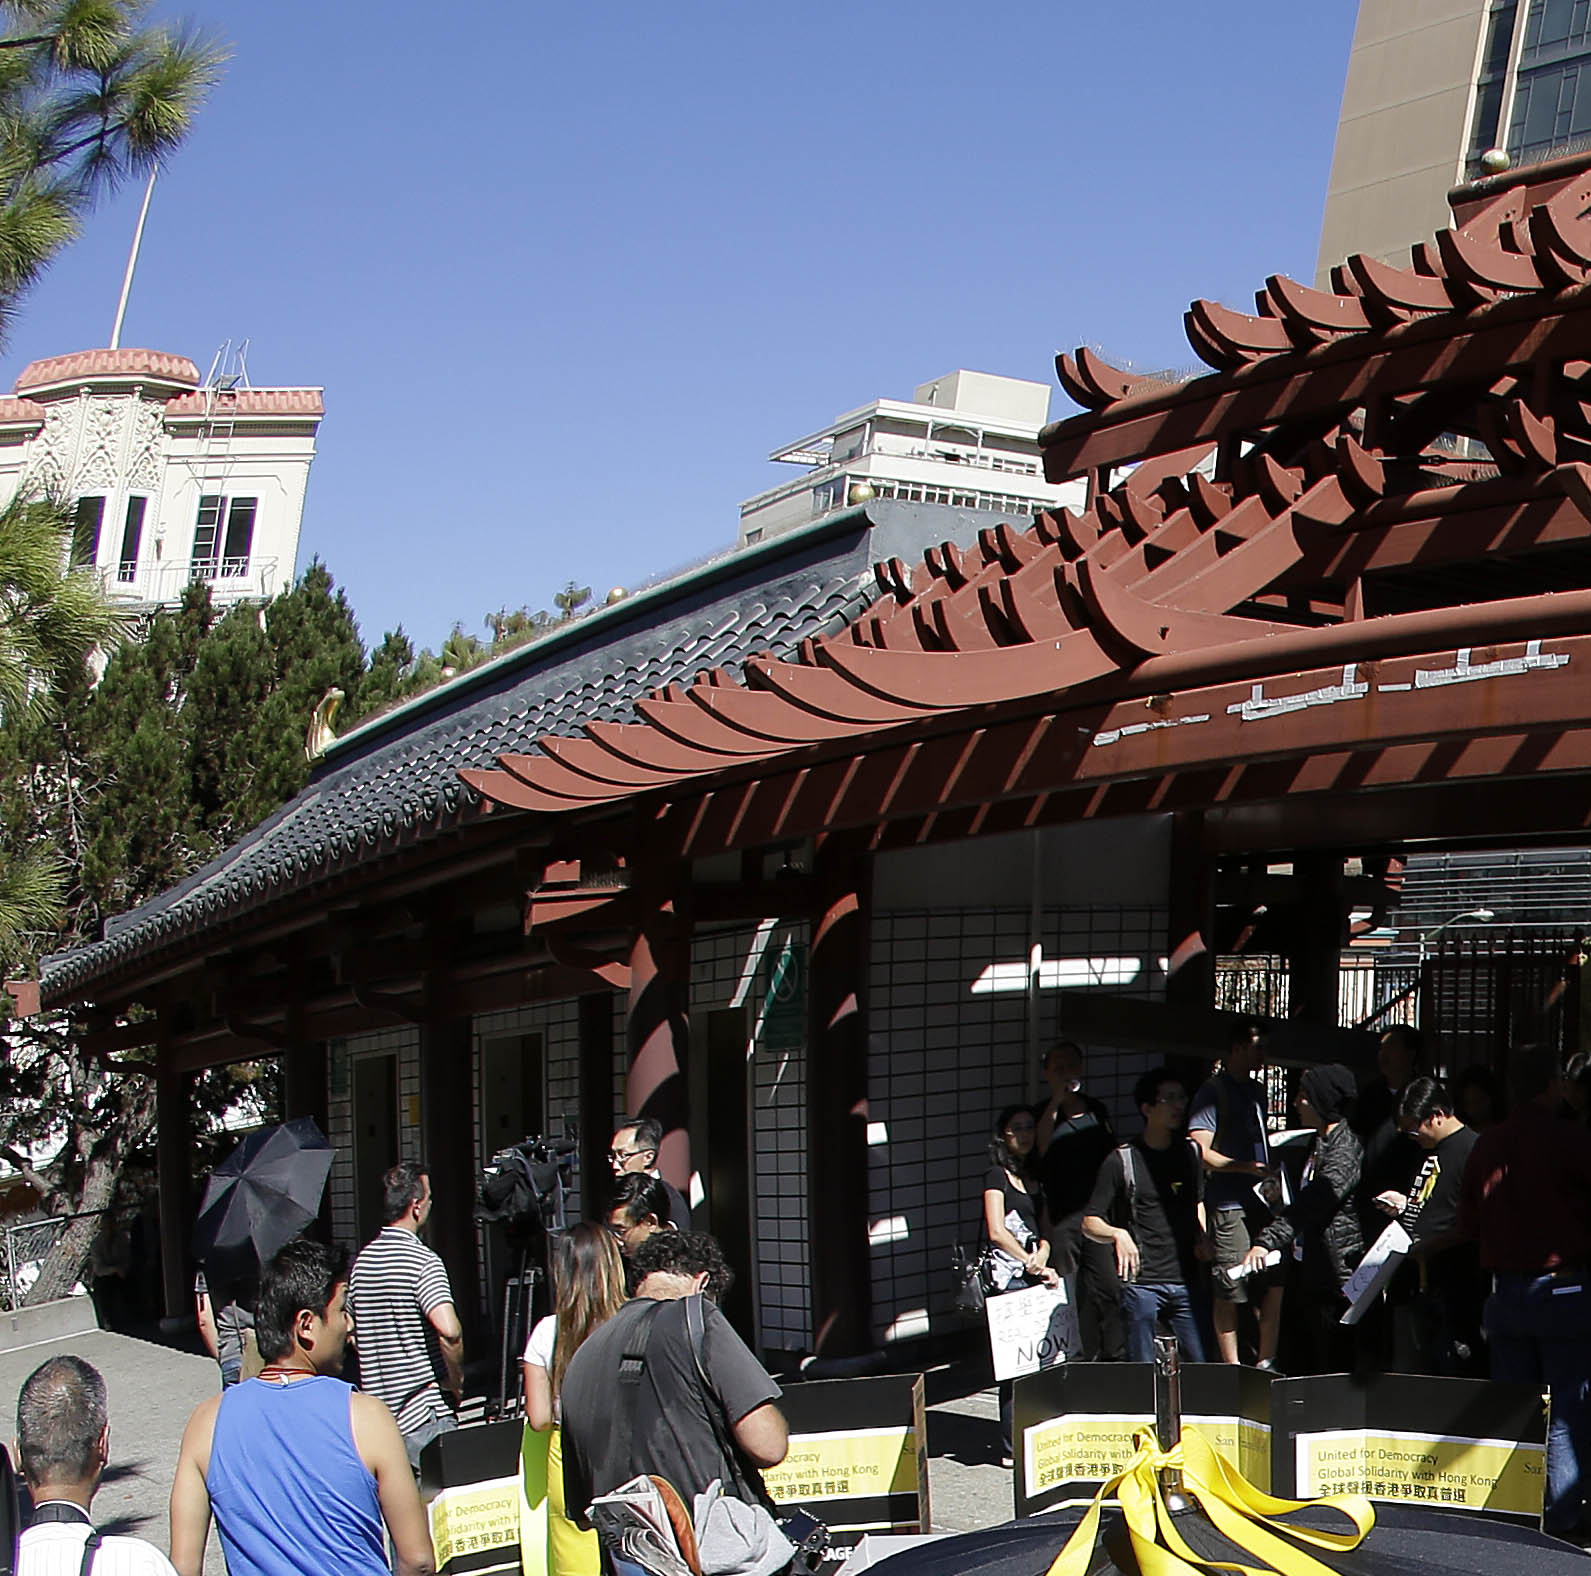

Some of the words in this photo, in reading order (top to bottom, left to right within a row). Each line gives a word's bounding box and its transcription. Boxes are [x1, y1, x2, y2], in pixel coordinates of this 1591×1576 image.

[1017, 1327, 1070, 1365] NOW
[1037, 1435, 1061, 1451] United
[1076, 1432, 1134, 1445] Democracy
[1062, 1447, 1107, 1462] Solidarity
[1109, 1447, 1133, 1459] with
[1318, 1449, 1357, 1462] United
[1360, 1448, 1377, 1459] for
[1378, 1449, 1439, 1466] Democracy
[795, 1468, 819, 1479] with
[822, 1465, 850, 1479] Hong
[852, 1463, 880, 1476] Kong
[1318, 1467, 1356, 1480] Global
[1357, 1465, 1409, 1481] Solidarity
[1411, 1470, 1436, 1482] with
[1438, 1472, 1468, 1487] Hong
[1470, 1475, 1499, 1490] Kong
[455, 1498, 513, 1518] Democracy
[488, 1515, 513, 1528] with
